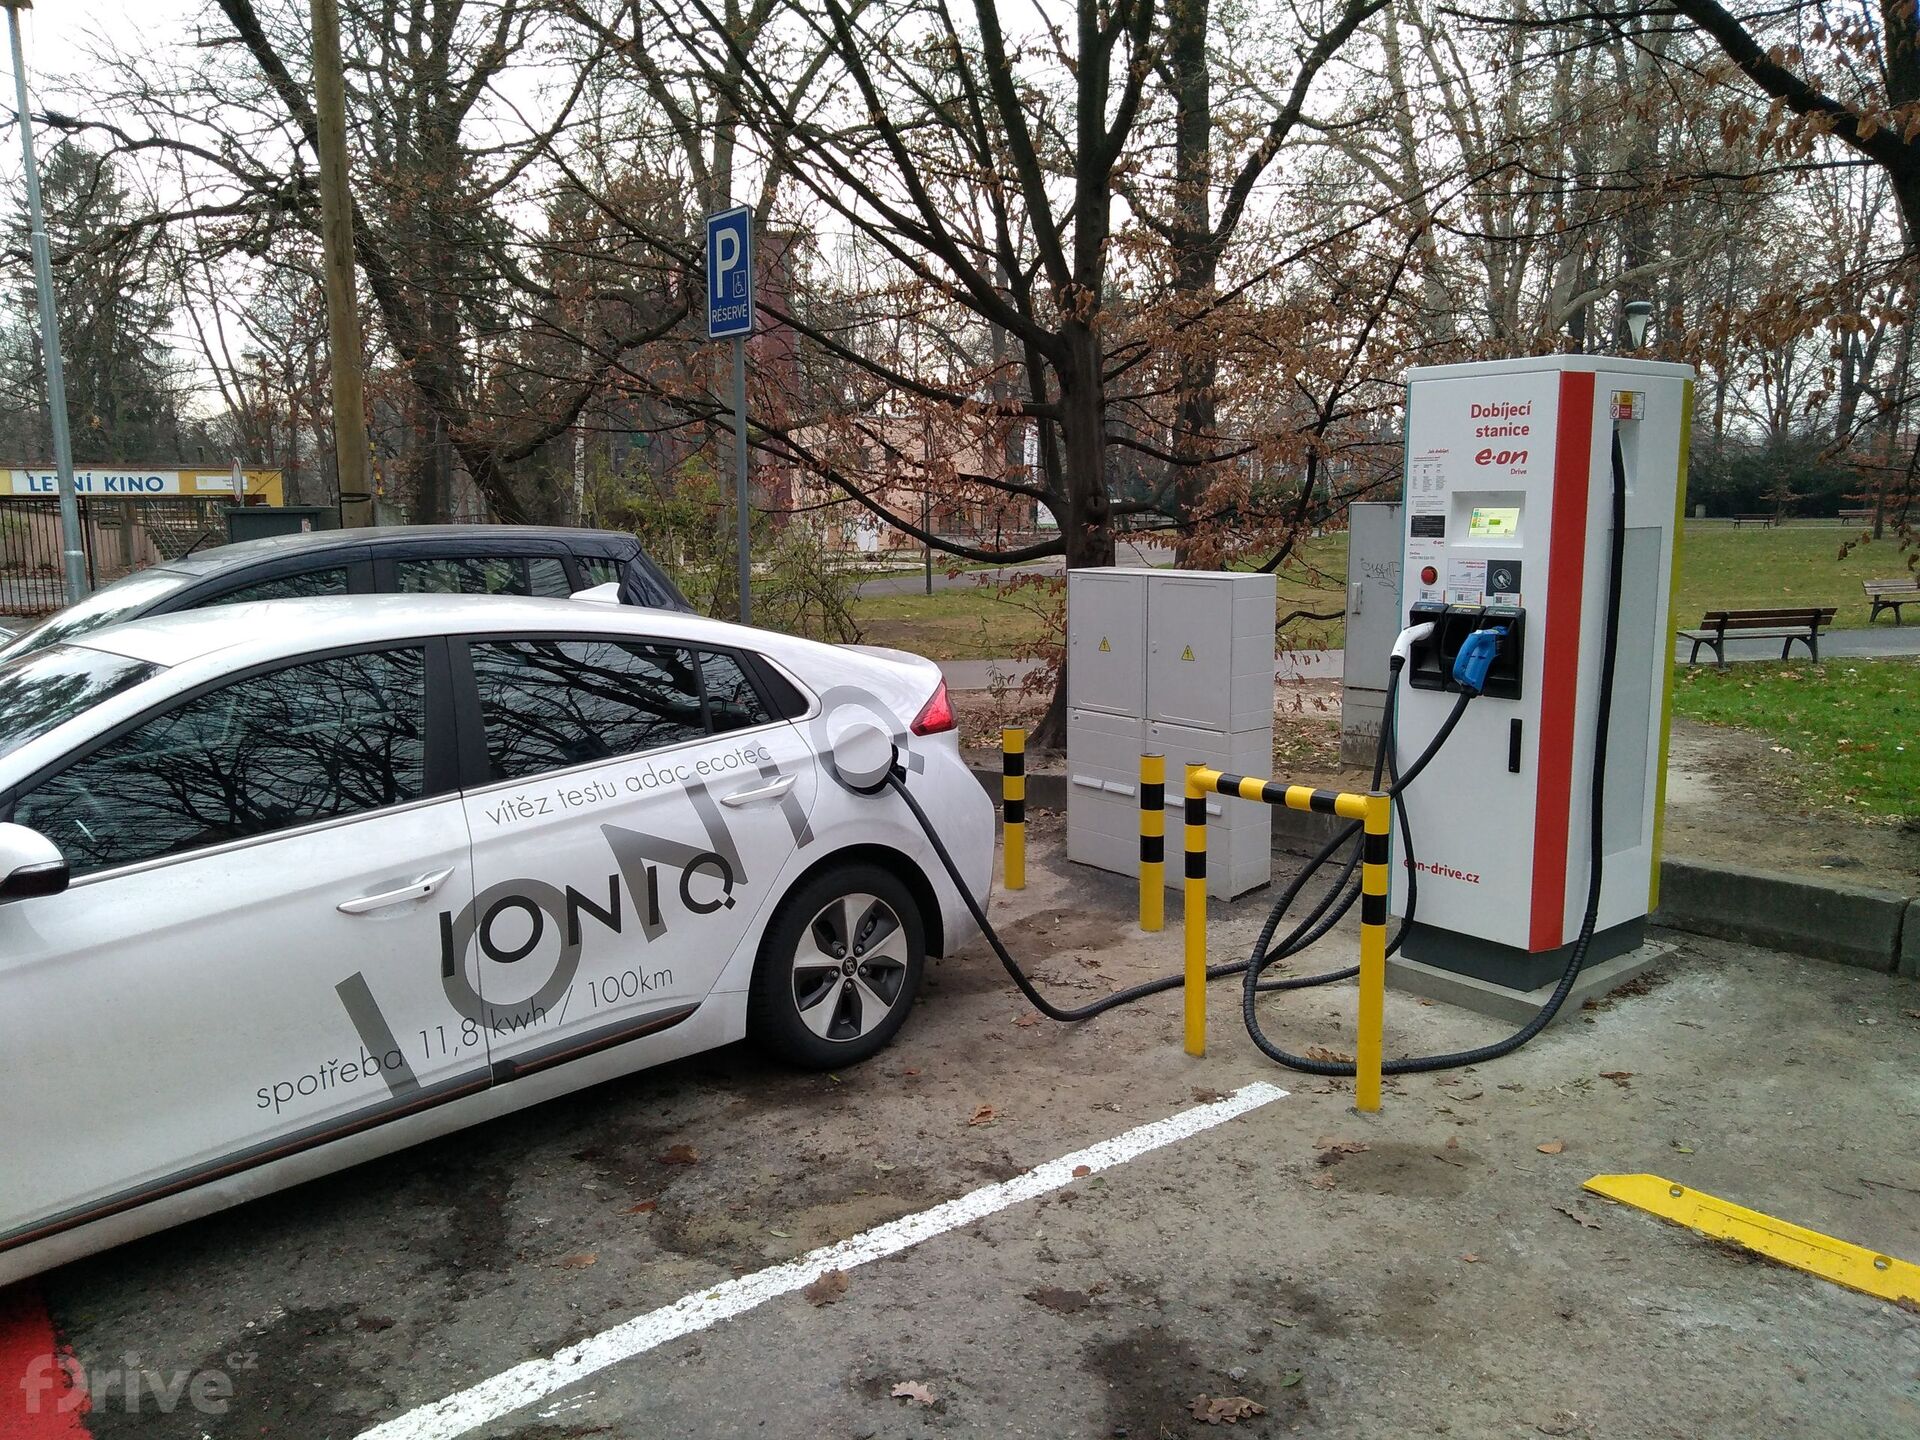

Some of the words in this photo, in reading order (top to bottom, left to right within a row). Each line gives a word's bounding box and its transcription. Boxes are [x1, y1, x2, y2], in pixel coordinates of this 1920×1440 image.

[716, 227, 740, 298] P
[712, 301, 748, 323] RÉSERVÉ
[1471, 400, 1532, 420] Dobíjecí
[1476, 422, 1530, 438] stanice
[29, 472, 92, 492] LENÍ
[105, 476, 164, 492] KINO
[485, 795, 554, 826] vítěz
[557, 781, 617, 809] testu
[625, 762, 691, 792] adac
[696, 745, 771, 775] ecotec
[439, 852, 736, 979] IONIQ
[256, 1046, 404, 1114] spotřeba
[419, 1017, 480, 1059] 11,8
[490, 997, 547, 1039] kwh
[558, 984, 573, 1025] /
[588, 965, 674, 1008] 100km
